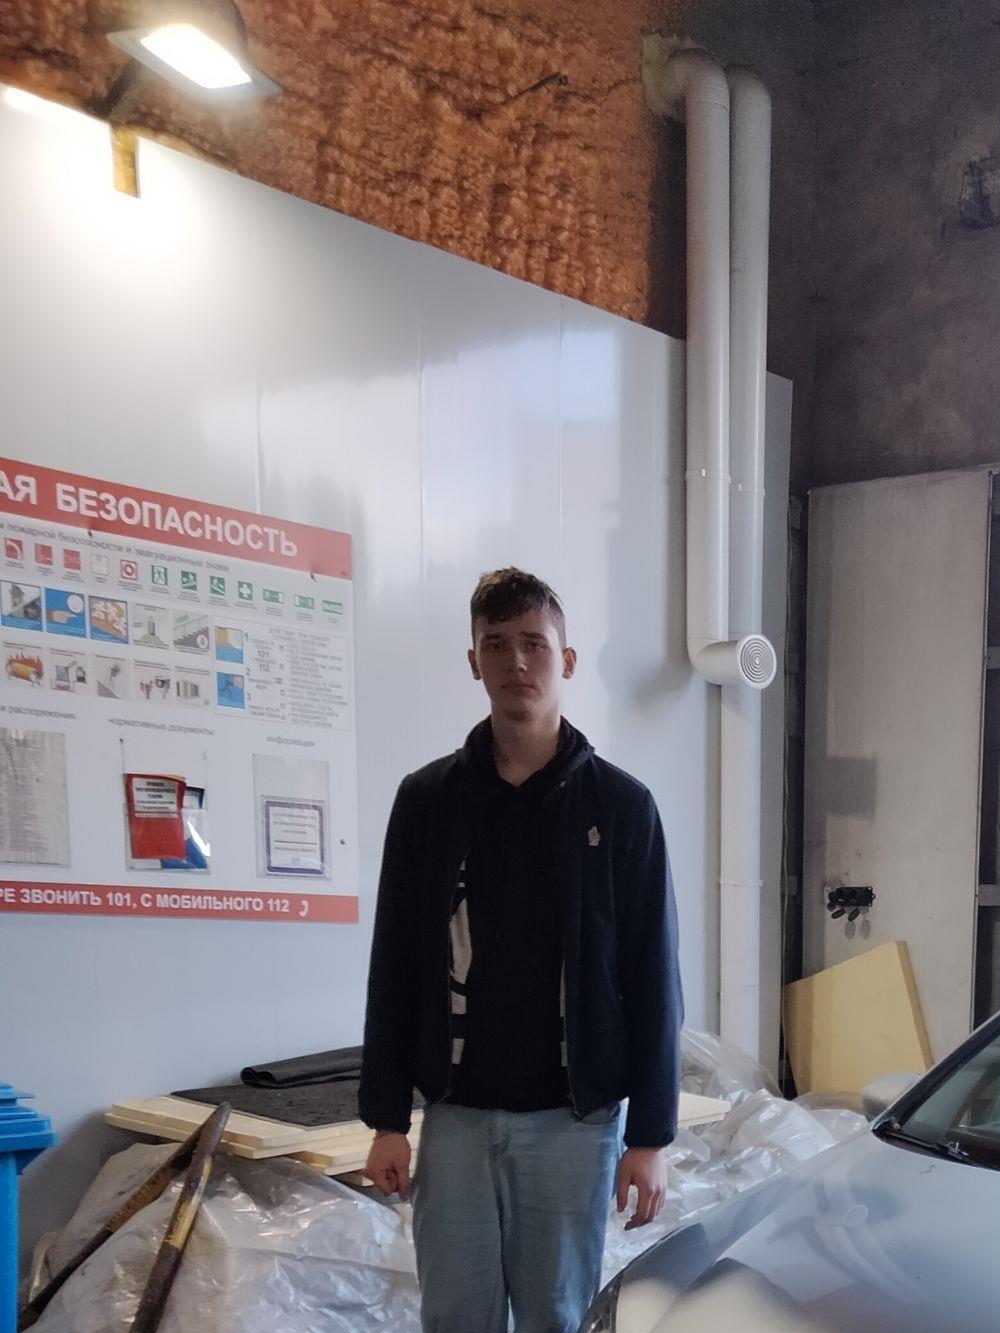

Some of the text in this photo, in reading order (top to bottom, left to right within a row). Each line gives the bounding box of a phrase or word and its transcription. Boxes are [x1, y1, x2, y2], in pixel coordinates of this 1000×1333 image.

[56, 483, 298, 557] БЕЗОПАСНОСТЬ
[20, 888, 103, 907] ЗВОНИТЬ
[106, 893, 137, 910] 101,
[140, 895, 153, 908] С
[156, 895, 264, 913] МОБИЛЬНОГО
[266, 900, 290, 914] 112
